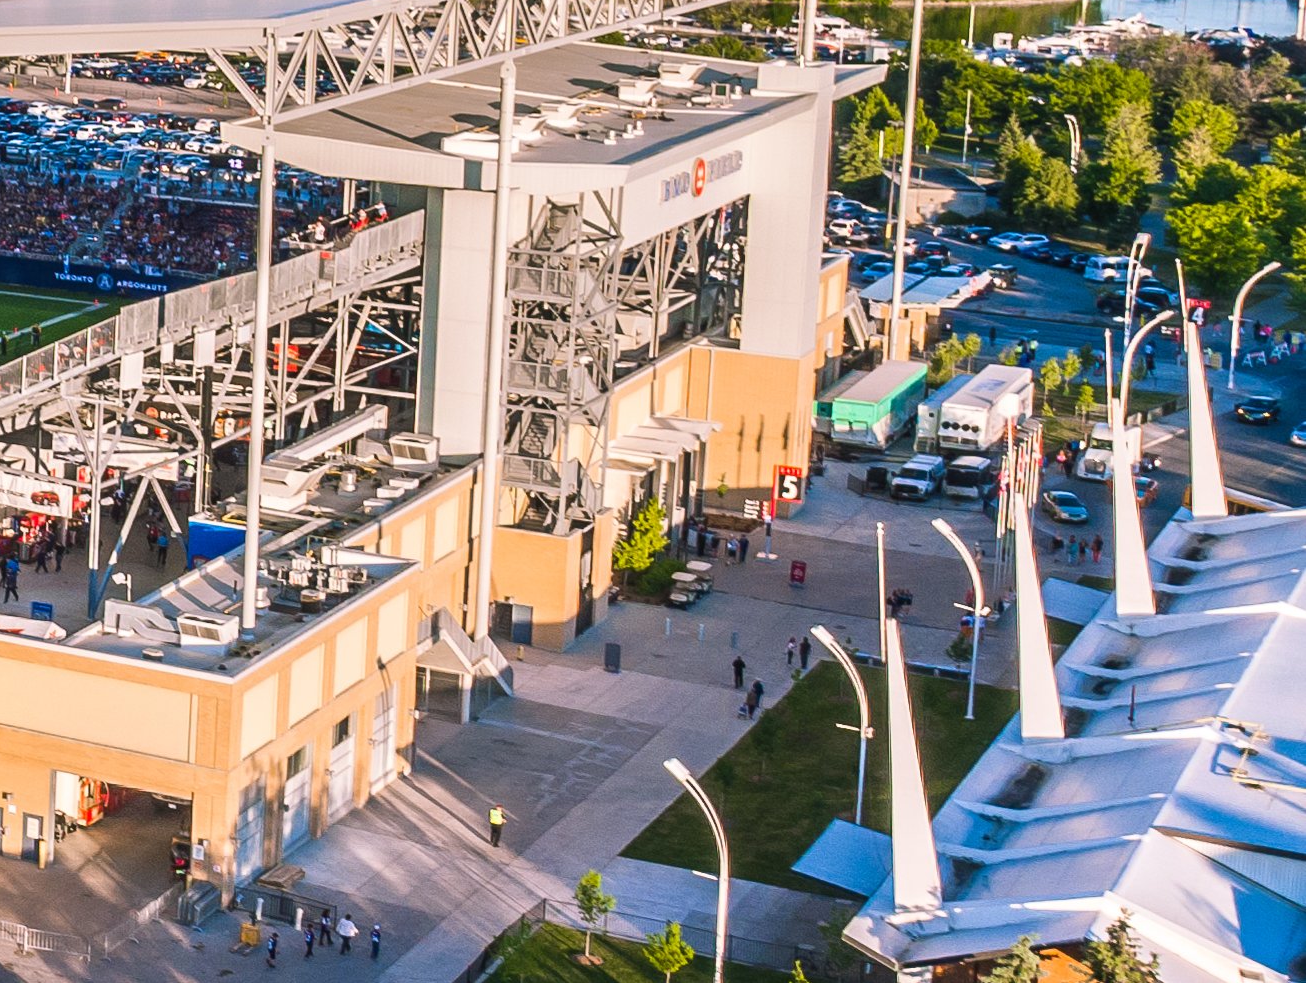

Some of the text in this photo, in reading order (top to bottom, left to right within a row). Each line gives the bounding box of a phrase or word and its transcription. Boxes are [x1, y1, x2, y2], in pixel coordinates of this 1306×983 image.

[54, 272, 94, 283] TORONTO
[116, 280, 168, 292] ARGONAUTS
[1192, 306, 1204, 325] 4
[781, 475, 798, 500] 5
